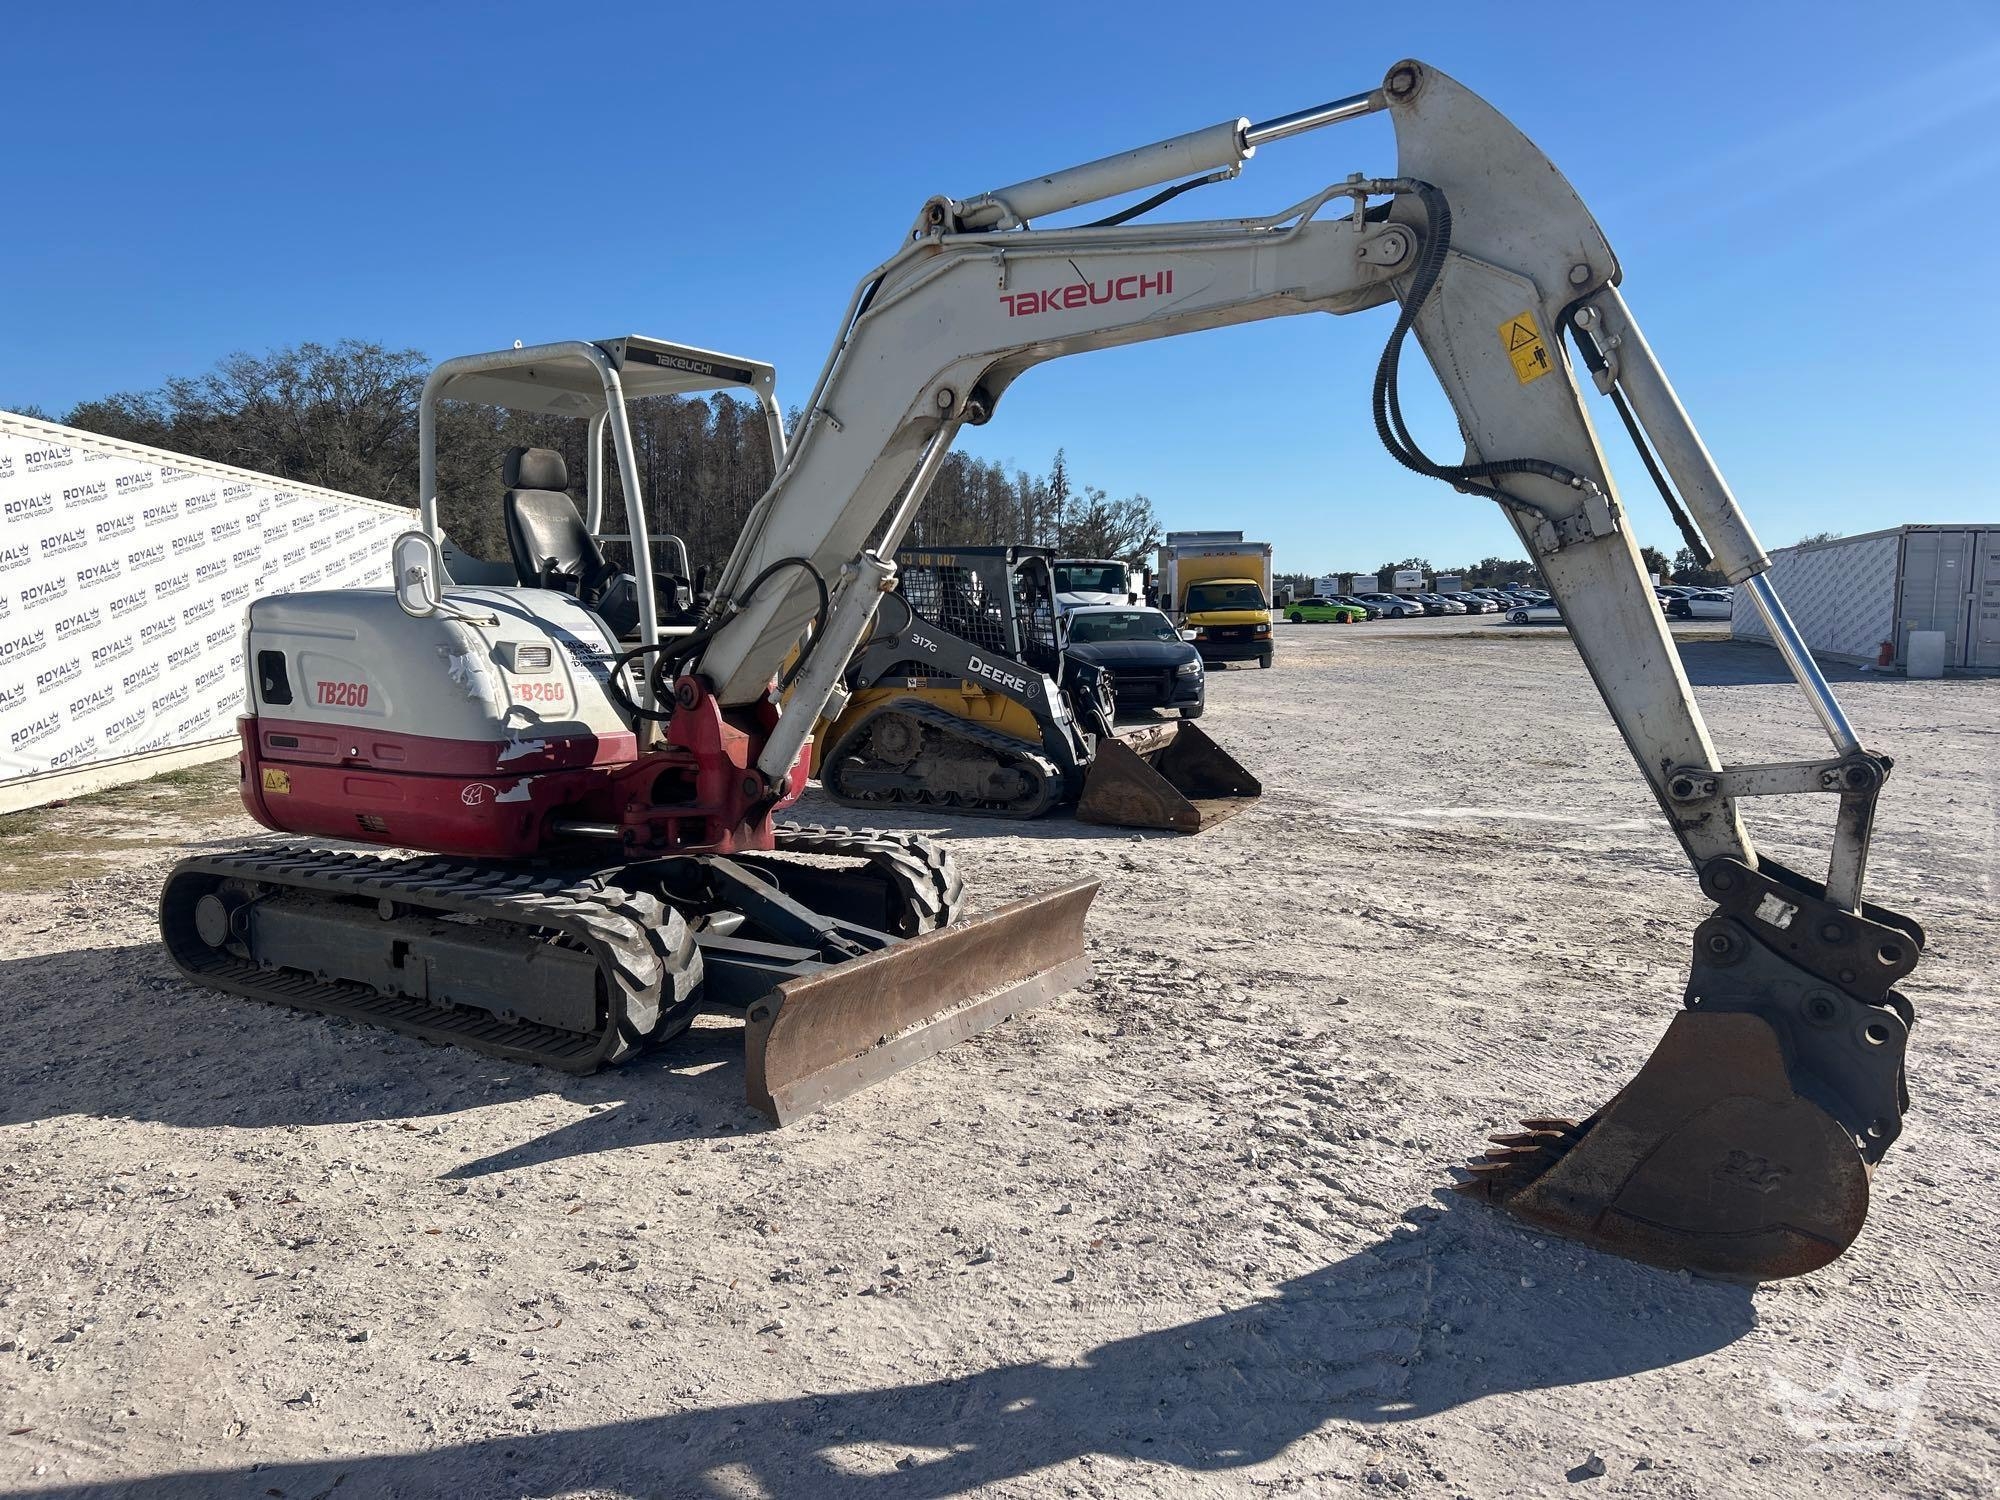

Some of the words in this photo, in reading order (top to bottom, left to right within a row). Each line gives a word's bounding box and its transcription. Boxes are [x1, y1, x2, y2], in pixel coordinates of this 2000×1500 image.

[25, 448, 62, 464] ROYAL
[28, 464, 53, 472] AUCTION
[115, 473, 145, 487] ROYAL
[63, 484, 97, 500] ROYAL
[118, 487, 138, 495] AUCTION
[223, 484, 244, 497] ROYAL
[4, 496, 43, 514] ROYAL
[66, 499, 89, 508] AUCTION
[185, 493, 210, 507] ROYAL
[7, 513, 34, 522] AUCTION
[35, 508, 55, 516] GROUP
[143, 504, 170, 520] ROYAL
[318, 505, 334, 517] ROYAL
[96, 517, 127, 534] ROYAL
[211, 521, 233, 535] ROYAL
[292, 514, 309, 527] ROYAL
[41, 531, 76, 550] ROYAL
[98, 532, 120, 541] AUCTION
[172, 533, 197, 548] ROYAL
[263, 525, 282, 538] ROYAL
[44, 547, 69, 558] AUCTION
[69, 542, 87, 550] GROUP
[310, 537, 326, 550] ROYAL
[10, 558, 31, 567] GROUP
[128, 546, 156, 564] ROYAL
[130, 561, 150, 571] AUCTION
[150, 556, 165, 564] GROUP
[233, 547, 254, 562] ROYAL
[283, 549, 300, 562] ROYAL
[77, 563, 110, 582] ROYAL
[196, 561, 220, 577] ROYAL
[300, 571, 316, 585] ROYAL
[80, 578, 103, 589] AUCTION
[103, 572, 120, 581] GROUP
[155, 575, 182, 593] ROYAL
[20, 580, 57, 602] ROYAL
[221, 585, 243, 602] ROYAL
[23, 598, 49, 610] AUCTION
[49, 591, 69, 600] GROUP
[109, 592, 140, 611] ROYAL
[112, 607, 133, 619] AUCTION
[133, 601, 149, 610] GROUP
[182, 601, 207, 619] ROYAL
[55, 611, 90, 633] ROYAL
[58, 628, 82, 641] AUCTION
[83, 620, 100, 631] GROUP
[140, 618, 168, 638] ROYAL
[206, 626, 229, 644] ROYAL
[911, 633, 938, 653] 317G
[25, 643, 46, 655] GROUP
[92, 639, 124, 661] ROYAL
[95, 655, 117, 668] AUCTION
[117, 647, 133, 658] GROUP
[167, 644, 193, 664] ROYAL
[37, 661, 73, 686] ROYAL
[40, 679, 65, 694] AUCTION
[65, 670, 84, 682] GROUP
[122, 665, 151, 688] ROYAL
[195, 667, 219, 687] ROYAL
[968, 655, 1027, 693] DEERE
[124, 681, 145, 695] AUCTION
[145, 673, 160, 684] GROUP
[512, 683, 564, 701] TB260
[70, 689, 103, 714] ROYAL
[152, 689, 179, 711] ROYAL
[217, 689, 239, 710] ROYAL
[317, 681, 369, 707] TB260
[5, 696, 26, 711] GROUP
[73, 706, 96, 721] AUCTION
[96, 697, 114, 709] GROUP
[10, 717, 49, 745] ROYAL
[105, 713, 136, 738] ROYAL
[178, 711, 203, 733] ROYAL
[14, 736, 41, 753] AUCTION
[41, 725, 61, 738] GROUP
[108, 730, 129, 745] AUCTION
[129, 720, 145, 732] GROUP
[50, 742, 87, 768] ROYAL
